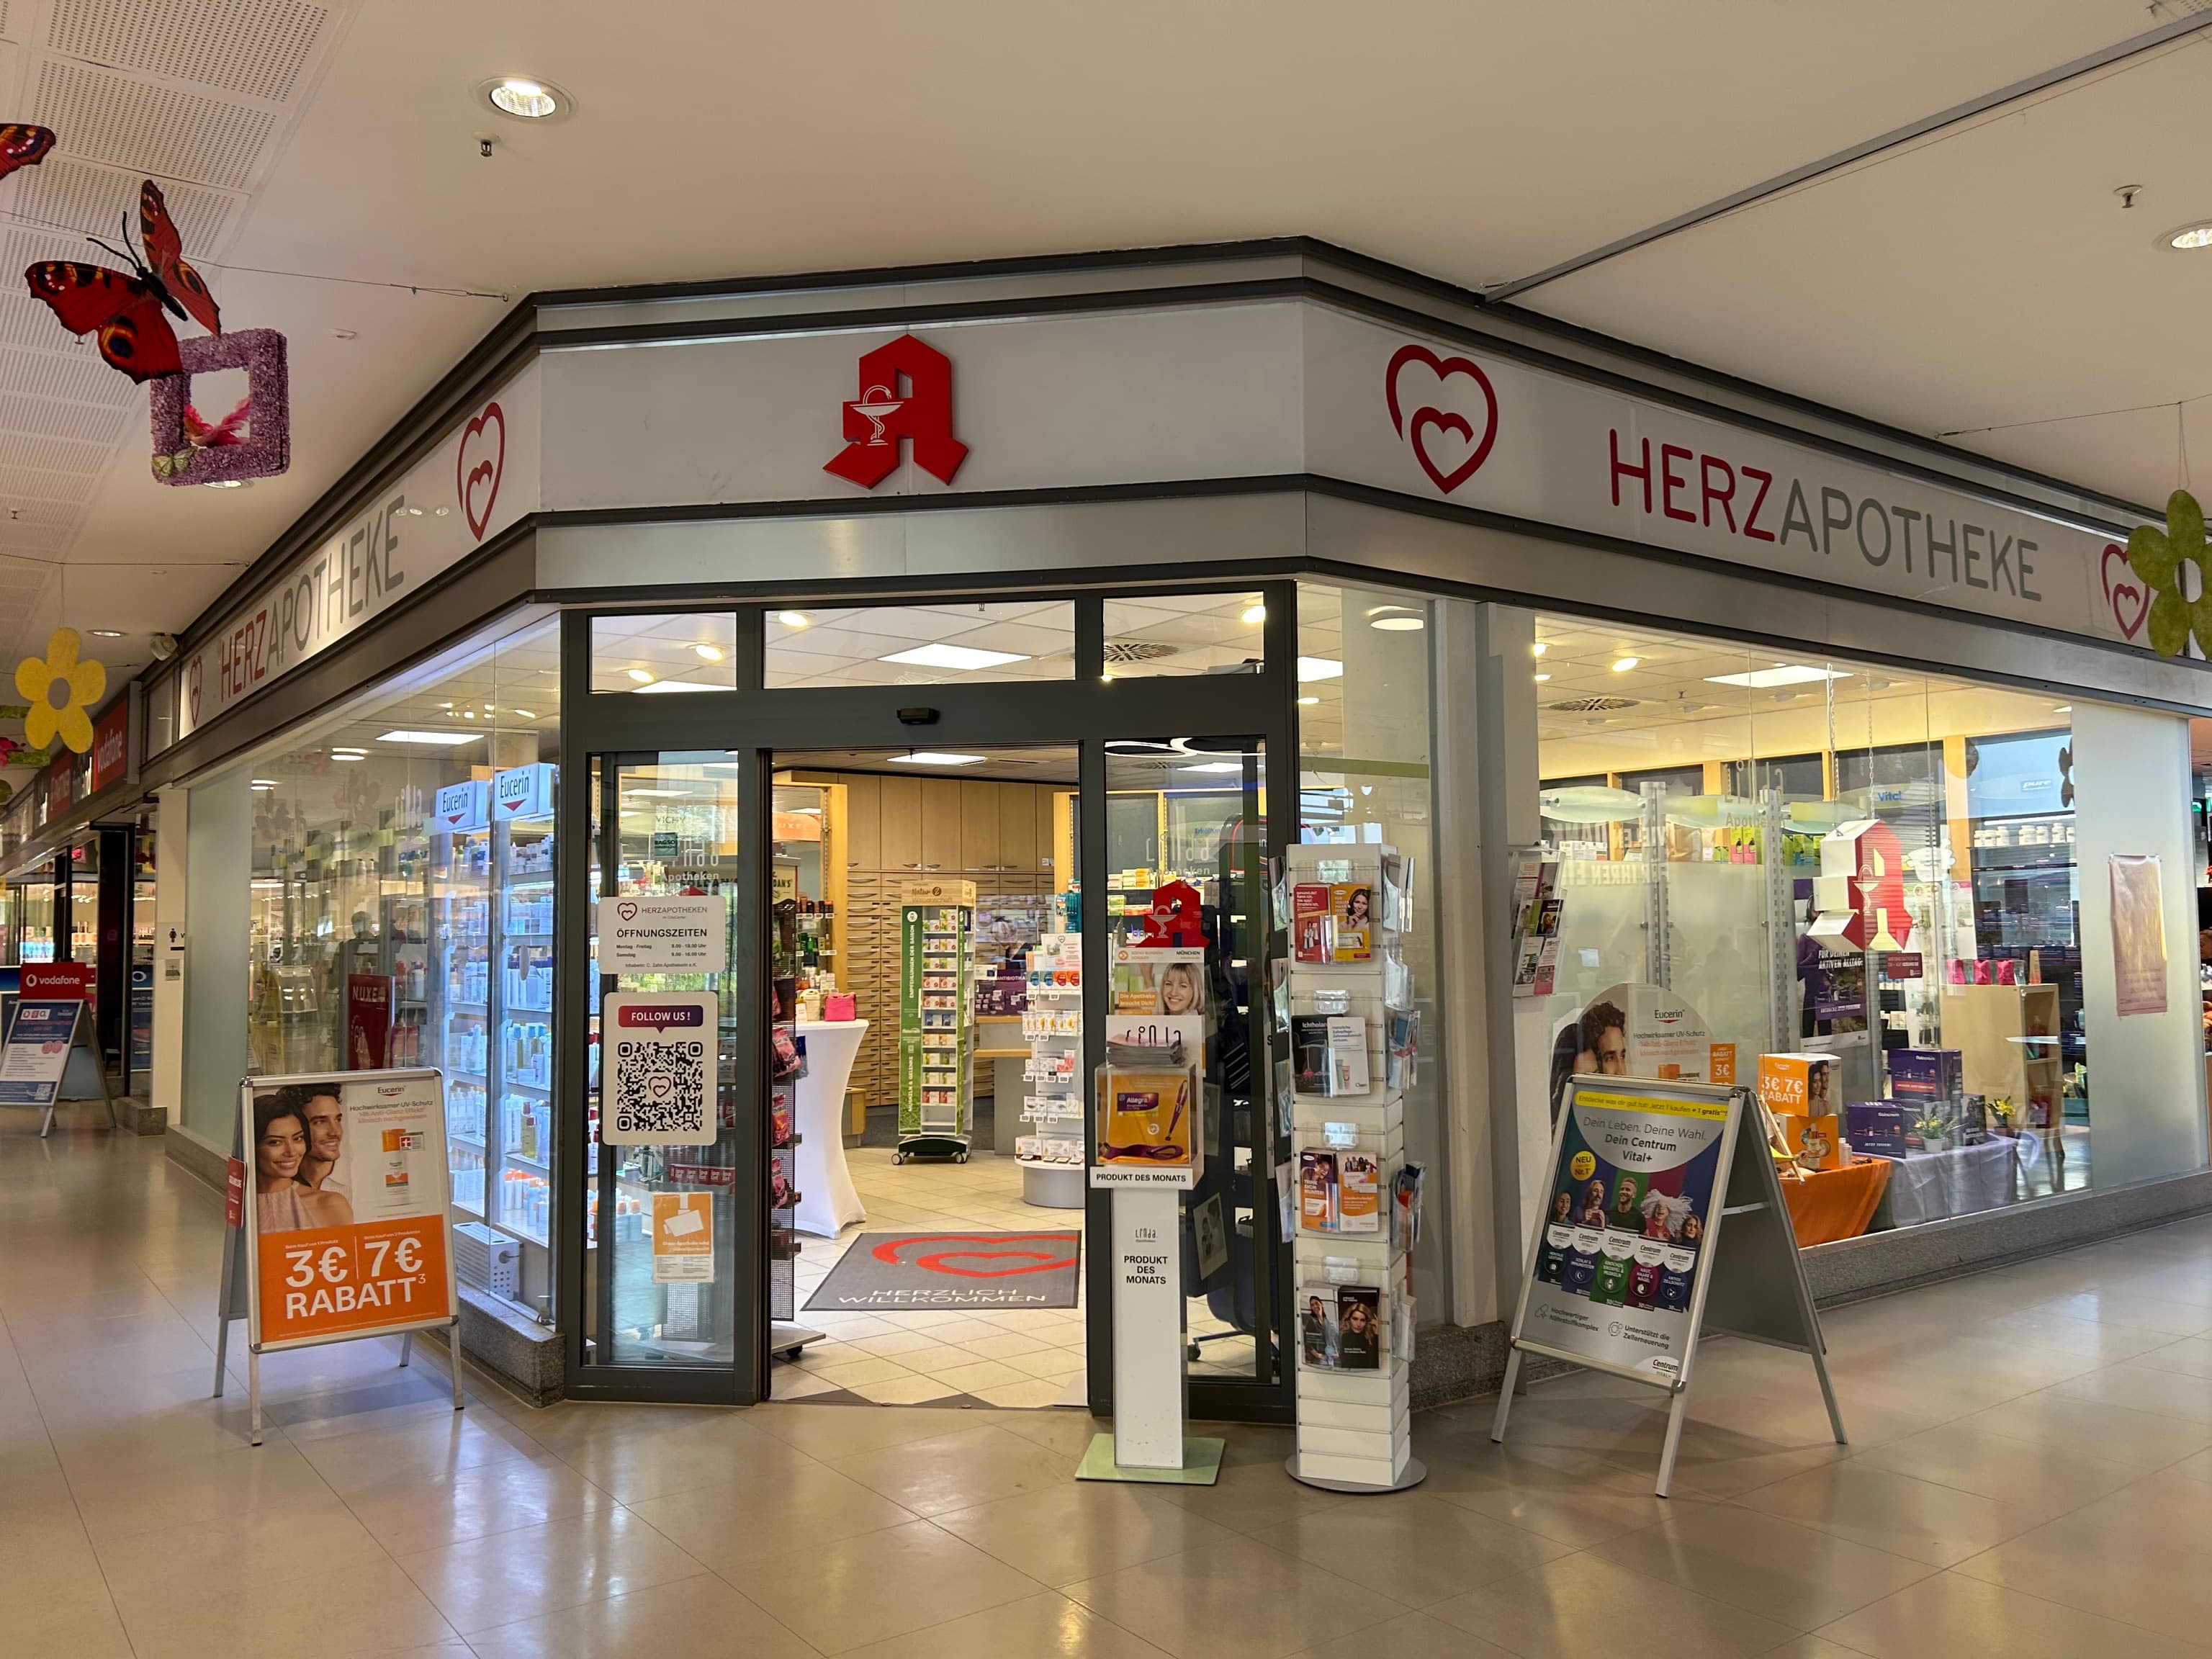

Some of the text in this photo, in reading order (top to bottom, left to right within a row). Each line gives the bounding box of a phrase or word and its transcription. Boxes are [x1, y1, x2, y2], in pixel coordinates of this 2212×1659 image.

[1609, 428, 2042, 602] HERZAPOTHEKE
[221, 494, 405, 703] HERZAPOTHEKE
[500, 770, 531, 799] Eucerin
[442, 787, 468, 812] Eucerin
[616, 927, 707, 938] ÖFFNUNGSZEITEN
[40, 975, 80, 985] vodafone
[631, 1012, 670, 1021] FOLLOW
[672, 1012, 685, 1021] US
[1654, 1009, 1683, 1019] Eucerin
[1583, 1116, 1707, 1141] Dein Leben. Deine Wahl.
[1605, 1133, 1677, 1151] Dein Centrum
[1622, 1150, 1653, 1163] Vital+
[1578, 1233, 1599, 1241] Centrum
[1609, 1236, 1631, 1246] Centrum
[1640, 1245, 1661, 1254] Centrum
[1124, 1255, 1168, 1264] PRODUKT
[1670, 1252, 1689, 1261] Centrum
[1126, 1275, 1166, 1285] MONATS
[1624, 1324, 1659, 1339] Unterstützt
[1622, 1333, 1669, 1349] Zellerneuerung
[1653, 1359, 1678, 1371] Centrum
